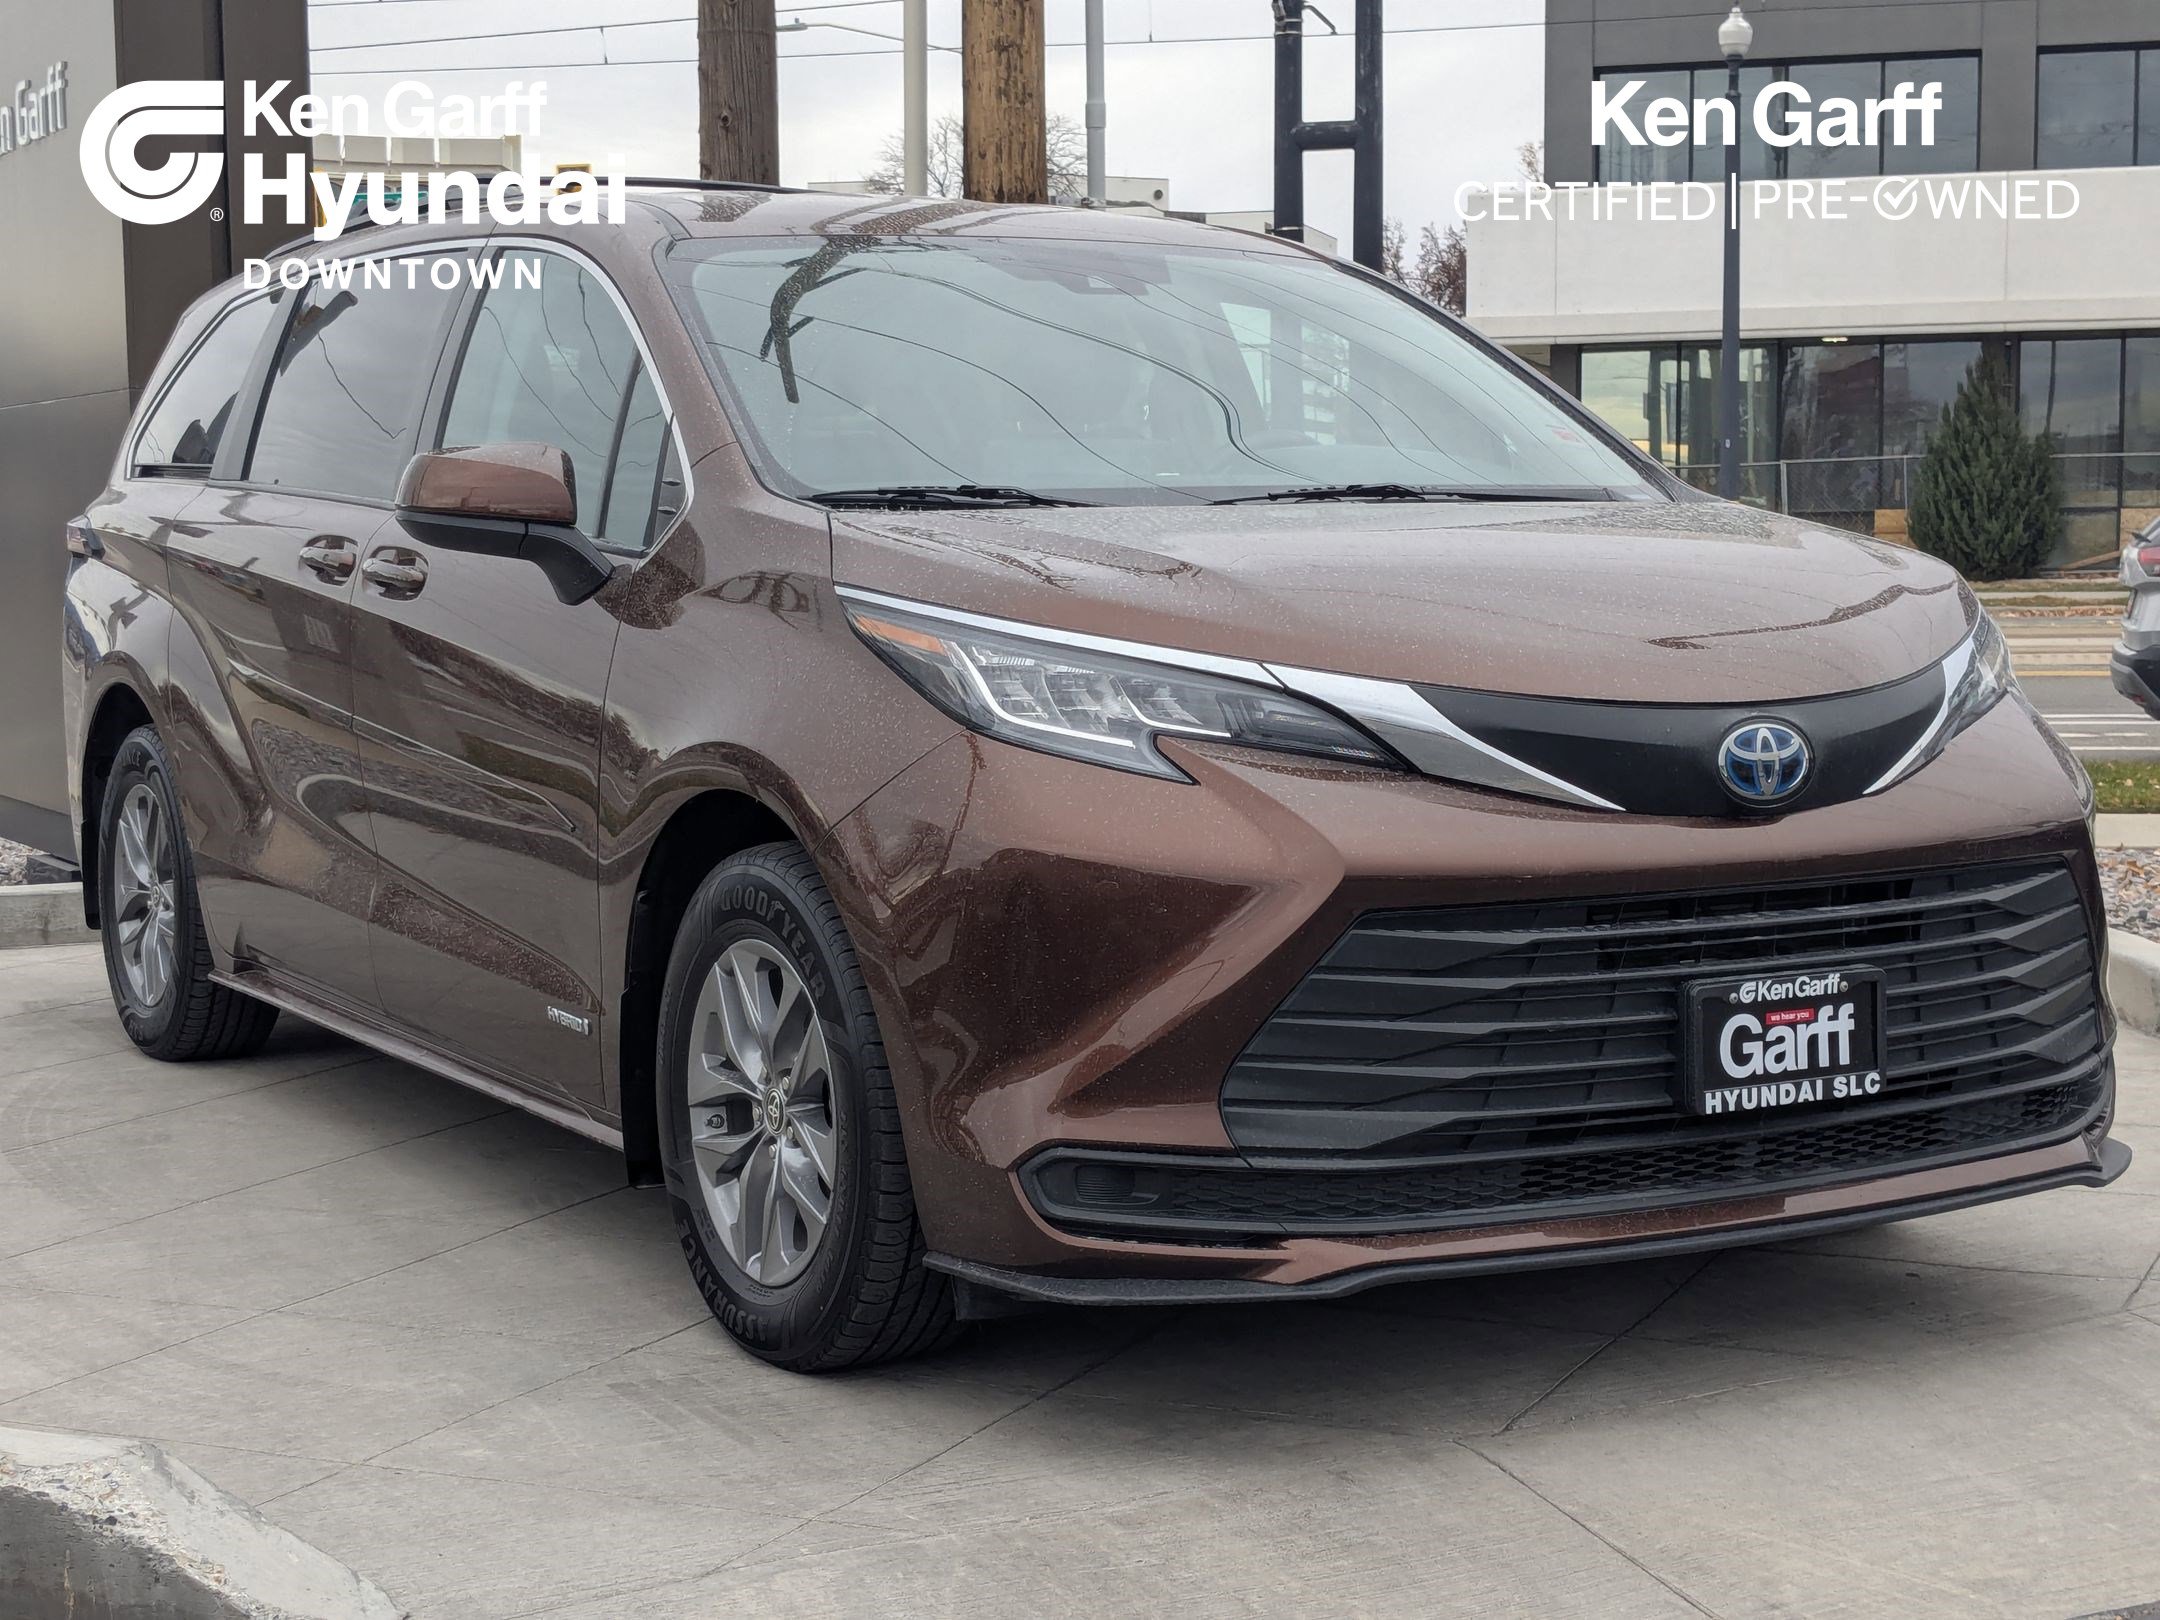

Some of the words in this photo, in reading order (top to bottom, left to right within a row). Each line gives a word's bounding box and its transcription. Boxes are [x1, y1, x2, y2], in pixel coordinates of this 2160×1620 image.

[16, 61, 68, 145] Garff
[1757, 979, 1793, 1002] Ken
[1794, 973, 1841, 998] Garff
[1719, 1002, 1855, 1079] Garff
[1705, 1079, 1823, 1115] HYUNDAI
[1832, 1071, 1881, 1099] SLC
